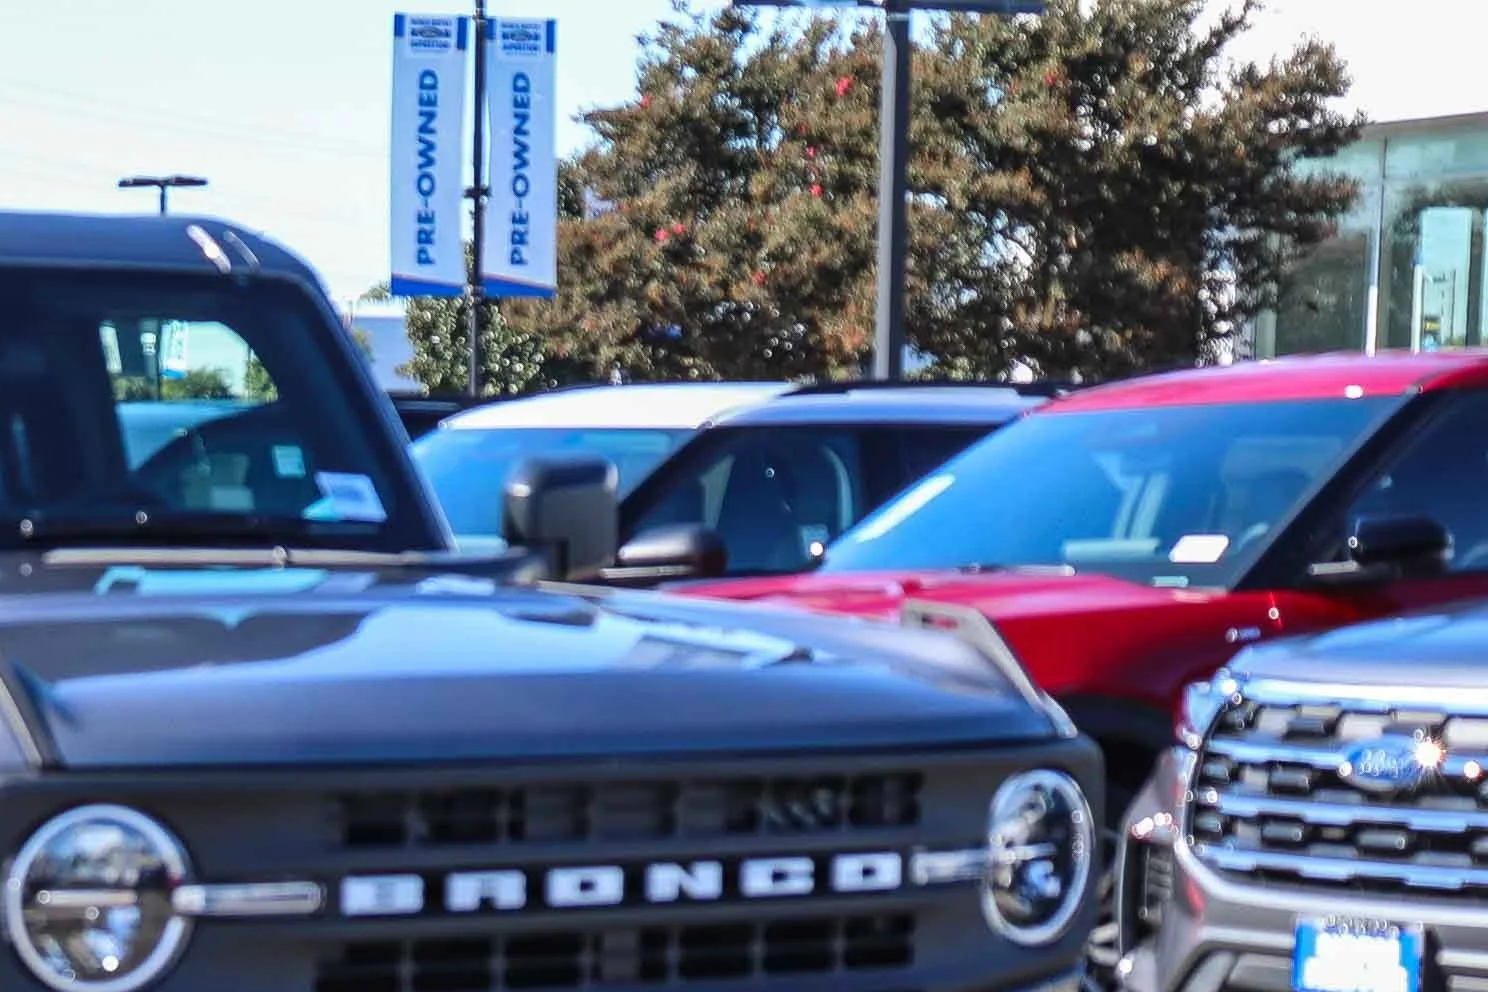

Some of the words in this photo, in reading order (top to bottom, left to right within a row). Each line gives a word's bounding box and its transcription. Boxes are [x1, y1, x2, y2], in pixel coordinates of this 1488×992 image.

[416, 68, 439, 266] PRE-OWNED
[510, 71, 531, 266] PRE-OWNED
[338, 850, 905, 918] BRONCO
